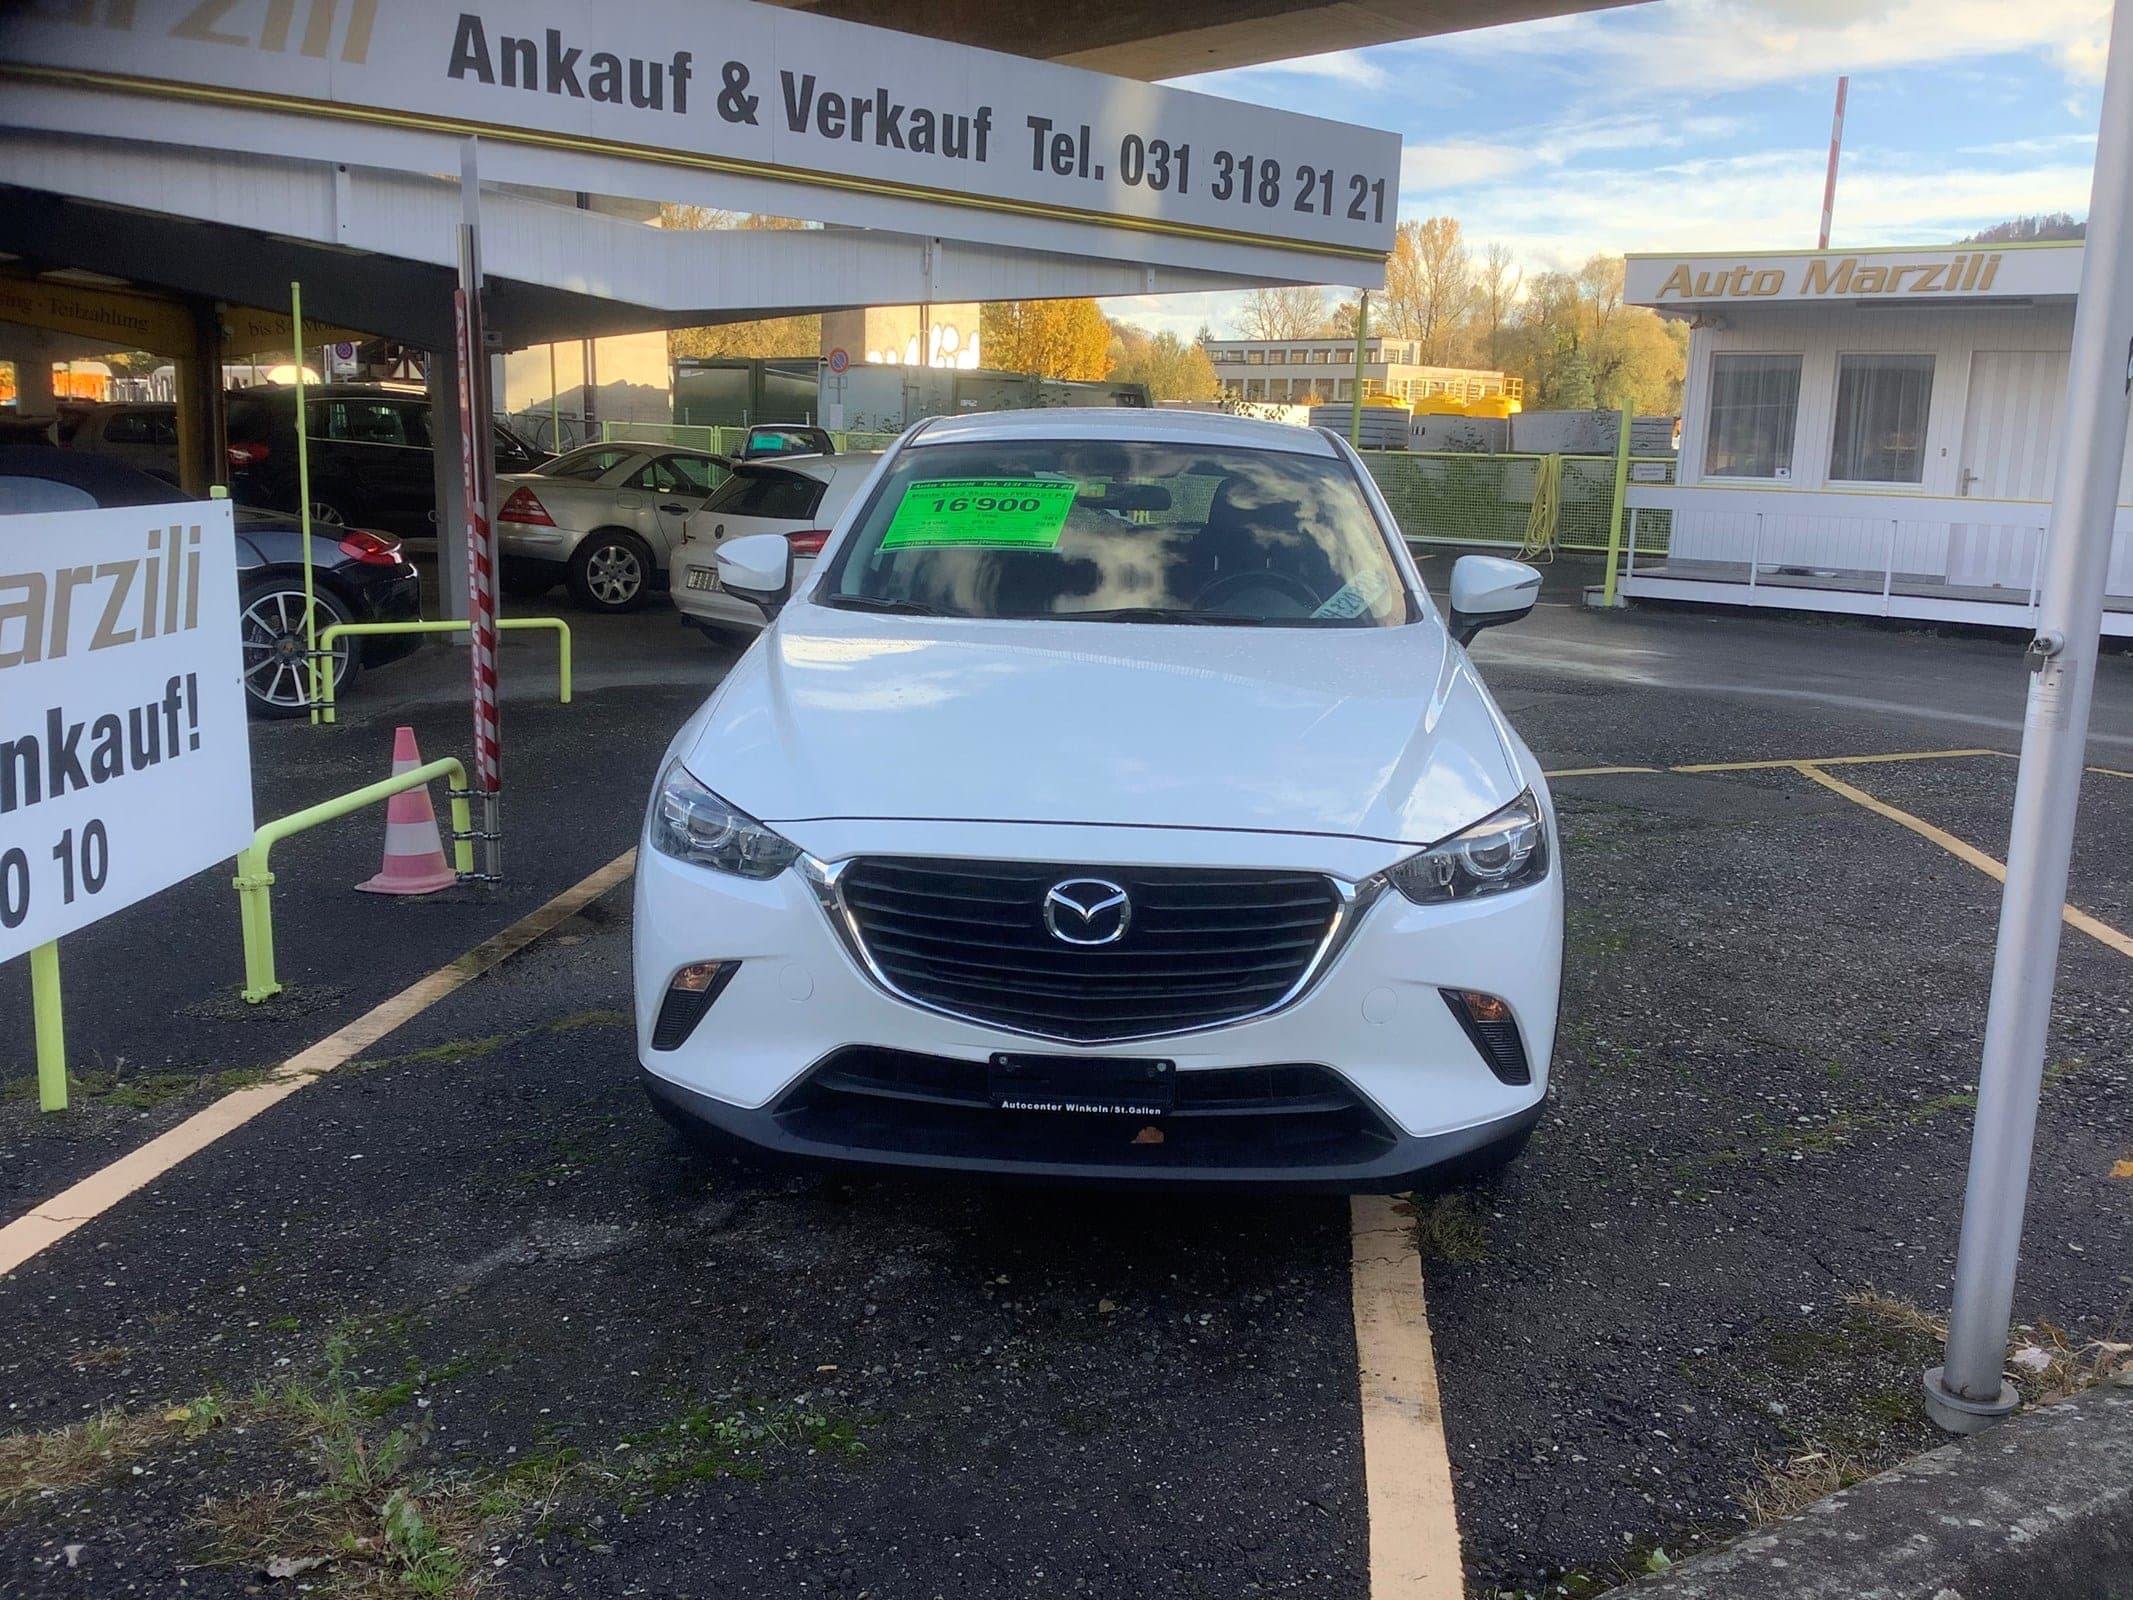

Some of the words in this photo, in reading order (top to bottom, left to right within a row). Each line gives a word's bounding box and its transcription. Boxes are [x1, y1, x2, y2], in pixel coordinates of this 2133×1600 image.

[447, 13, 692, 114] Ankauf
[717, 61, 759, 125] &
[780, 70, 992, 162] Verkauf
[1027, 115, 1104, 181] Tel.
[1120, 134, 1189, 194] 031
[1212, 150, 1279, 208] 318
[1295, 164, 1332, 216] 21
[1347, 174, 1385, 224] 21
[1656, 263, 1785, 299] Auto
[1801, 254, 2002, 294] Marzili
[932, 498, 1041, 513] 16'900
[53, 819, 109, 905] 10
[1001, 1101, 1063, 1112] Autocenter
